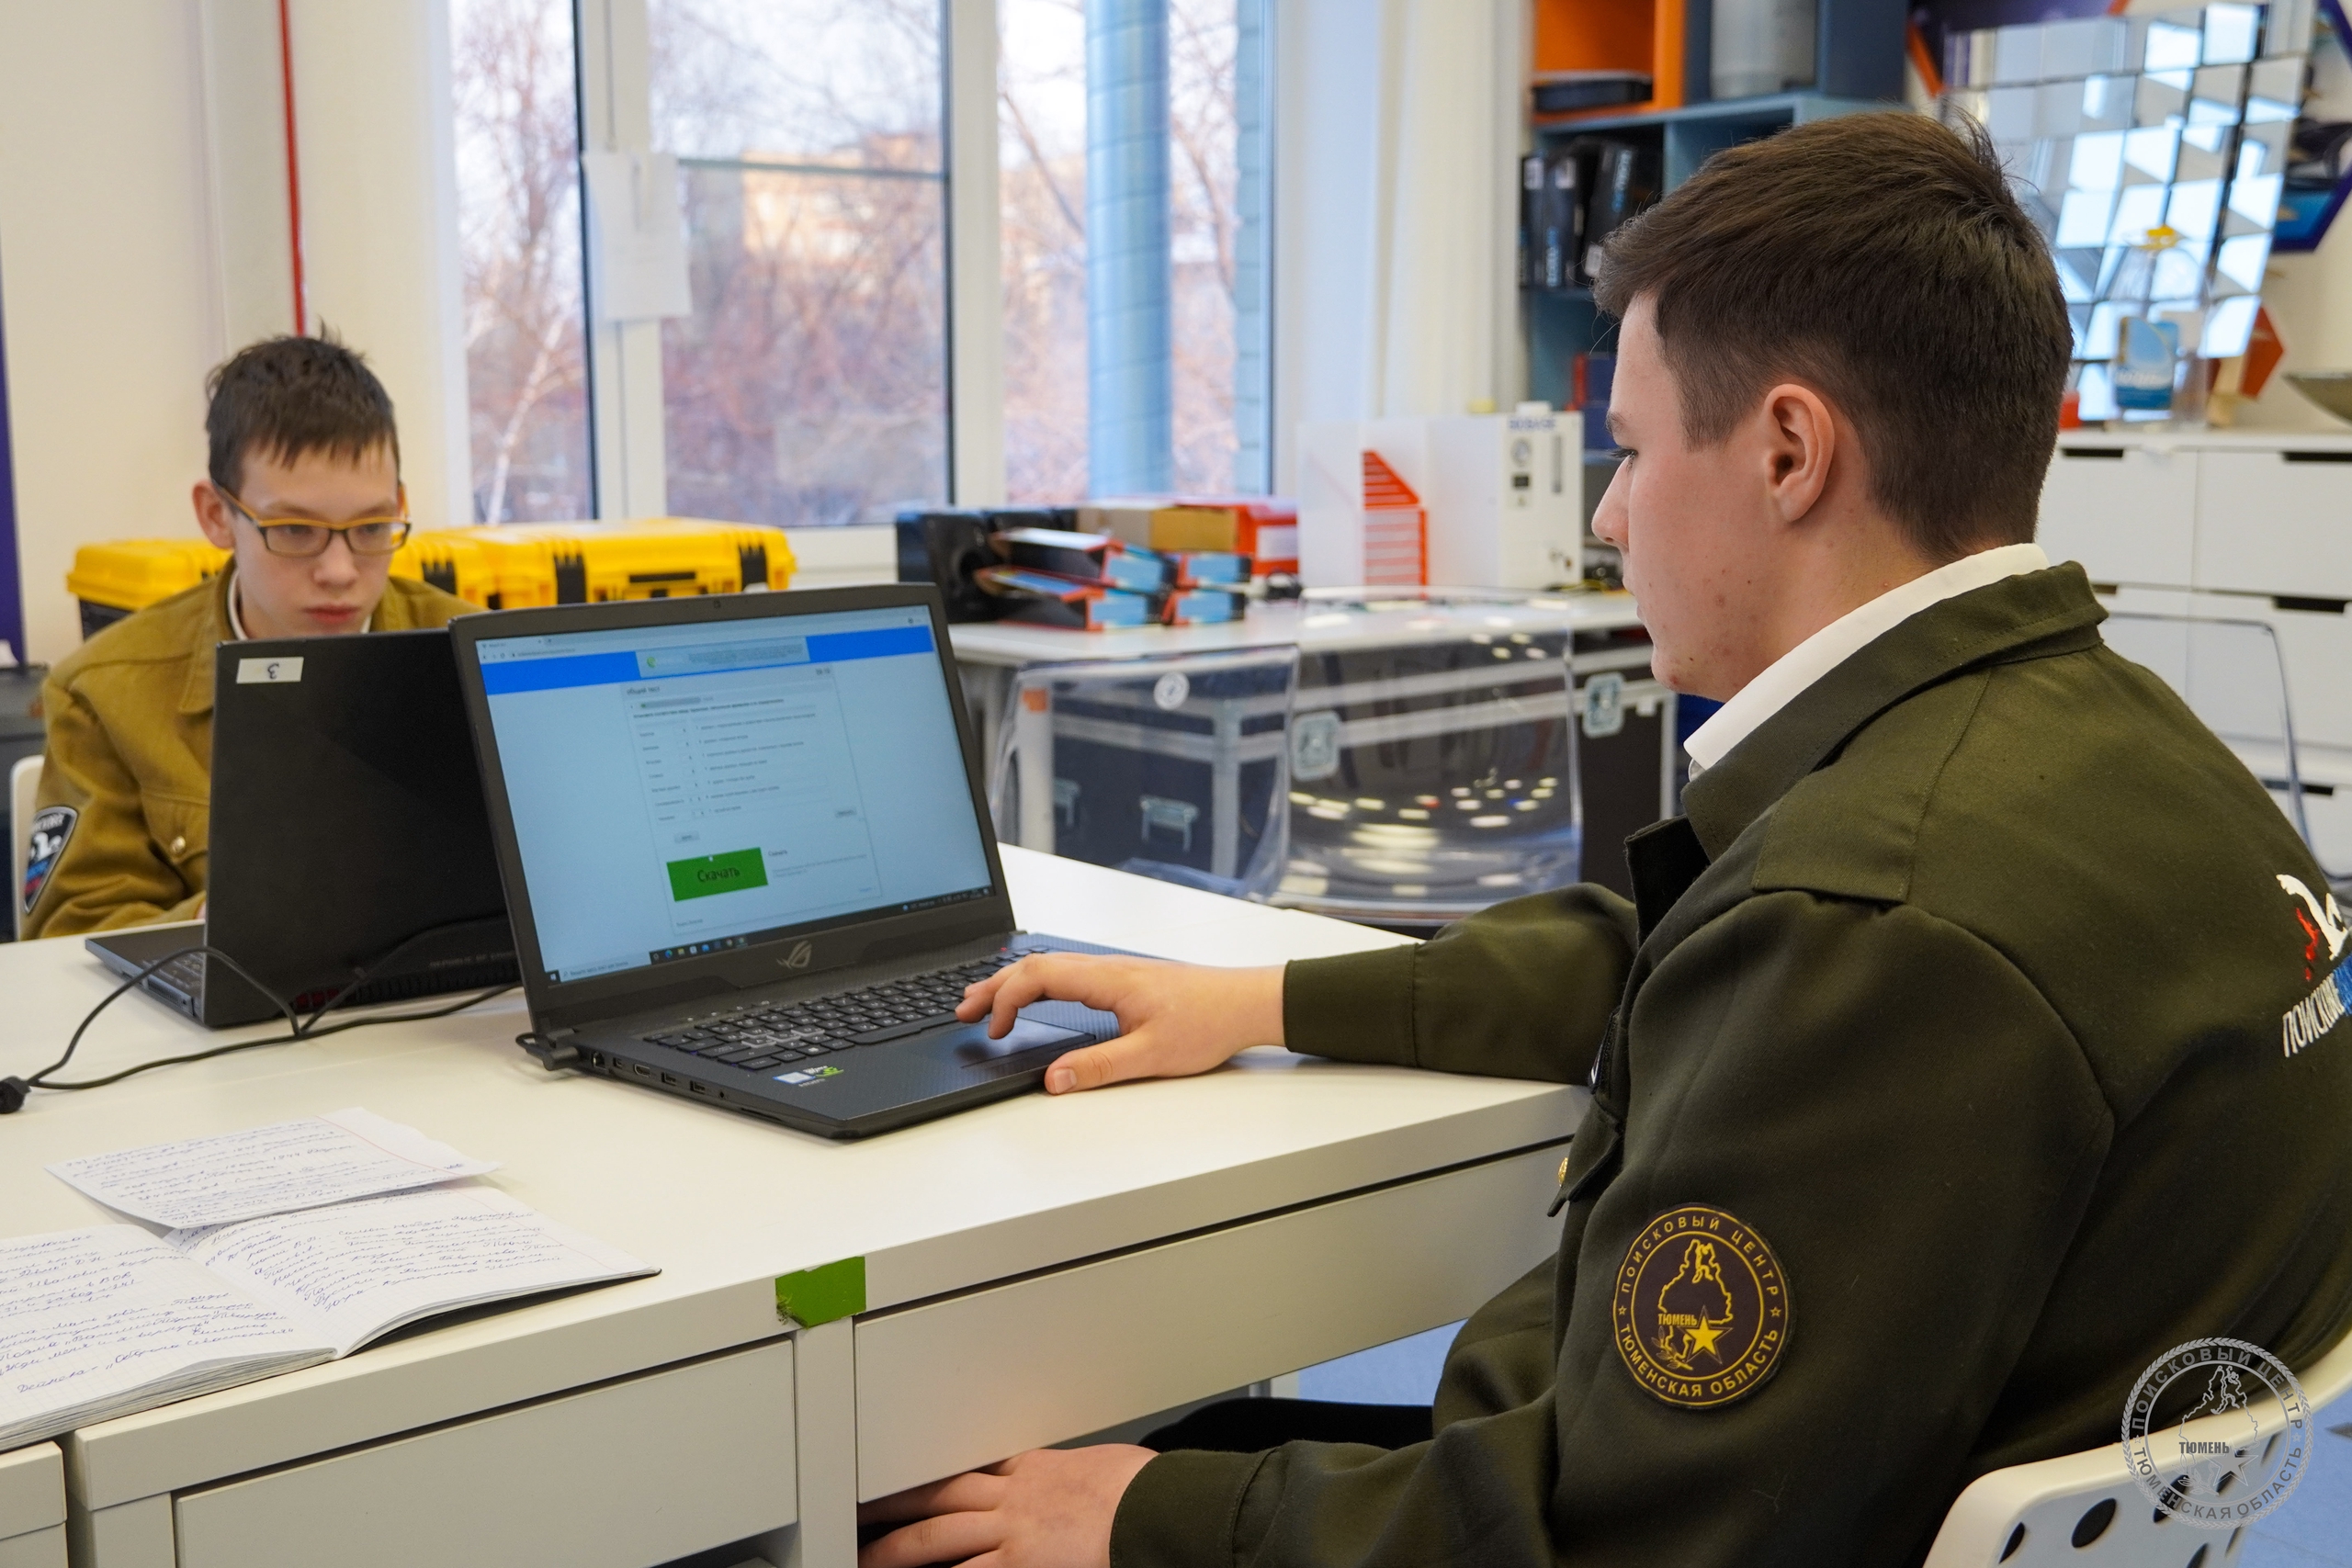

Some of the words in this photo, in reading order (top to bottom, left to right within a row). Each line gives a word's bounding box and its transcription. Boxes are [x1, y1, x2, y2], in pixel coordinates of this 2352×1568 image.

[696, 866, 741, 884] Скачать
[1621, 1214, 1721, 1294] ПОИСКОВЫЙ
[1730, 1228, 1780, 1296] ЦЕНТР
[1657, 1313, 1698, 1326] ТЮМЕНЬ
[1619, 1323, 1704, 1398] ТЮМЕНСКАЯ
[1710, 1329, 1779, 1396] ОБЛАСТЬ
